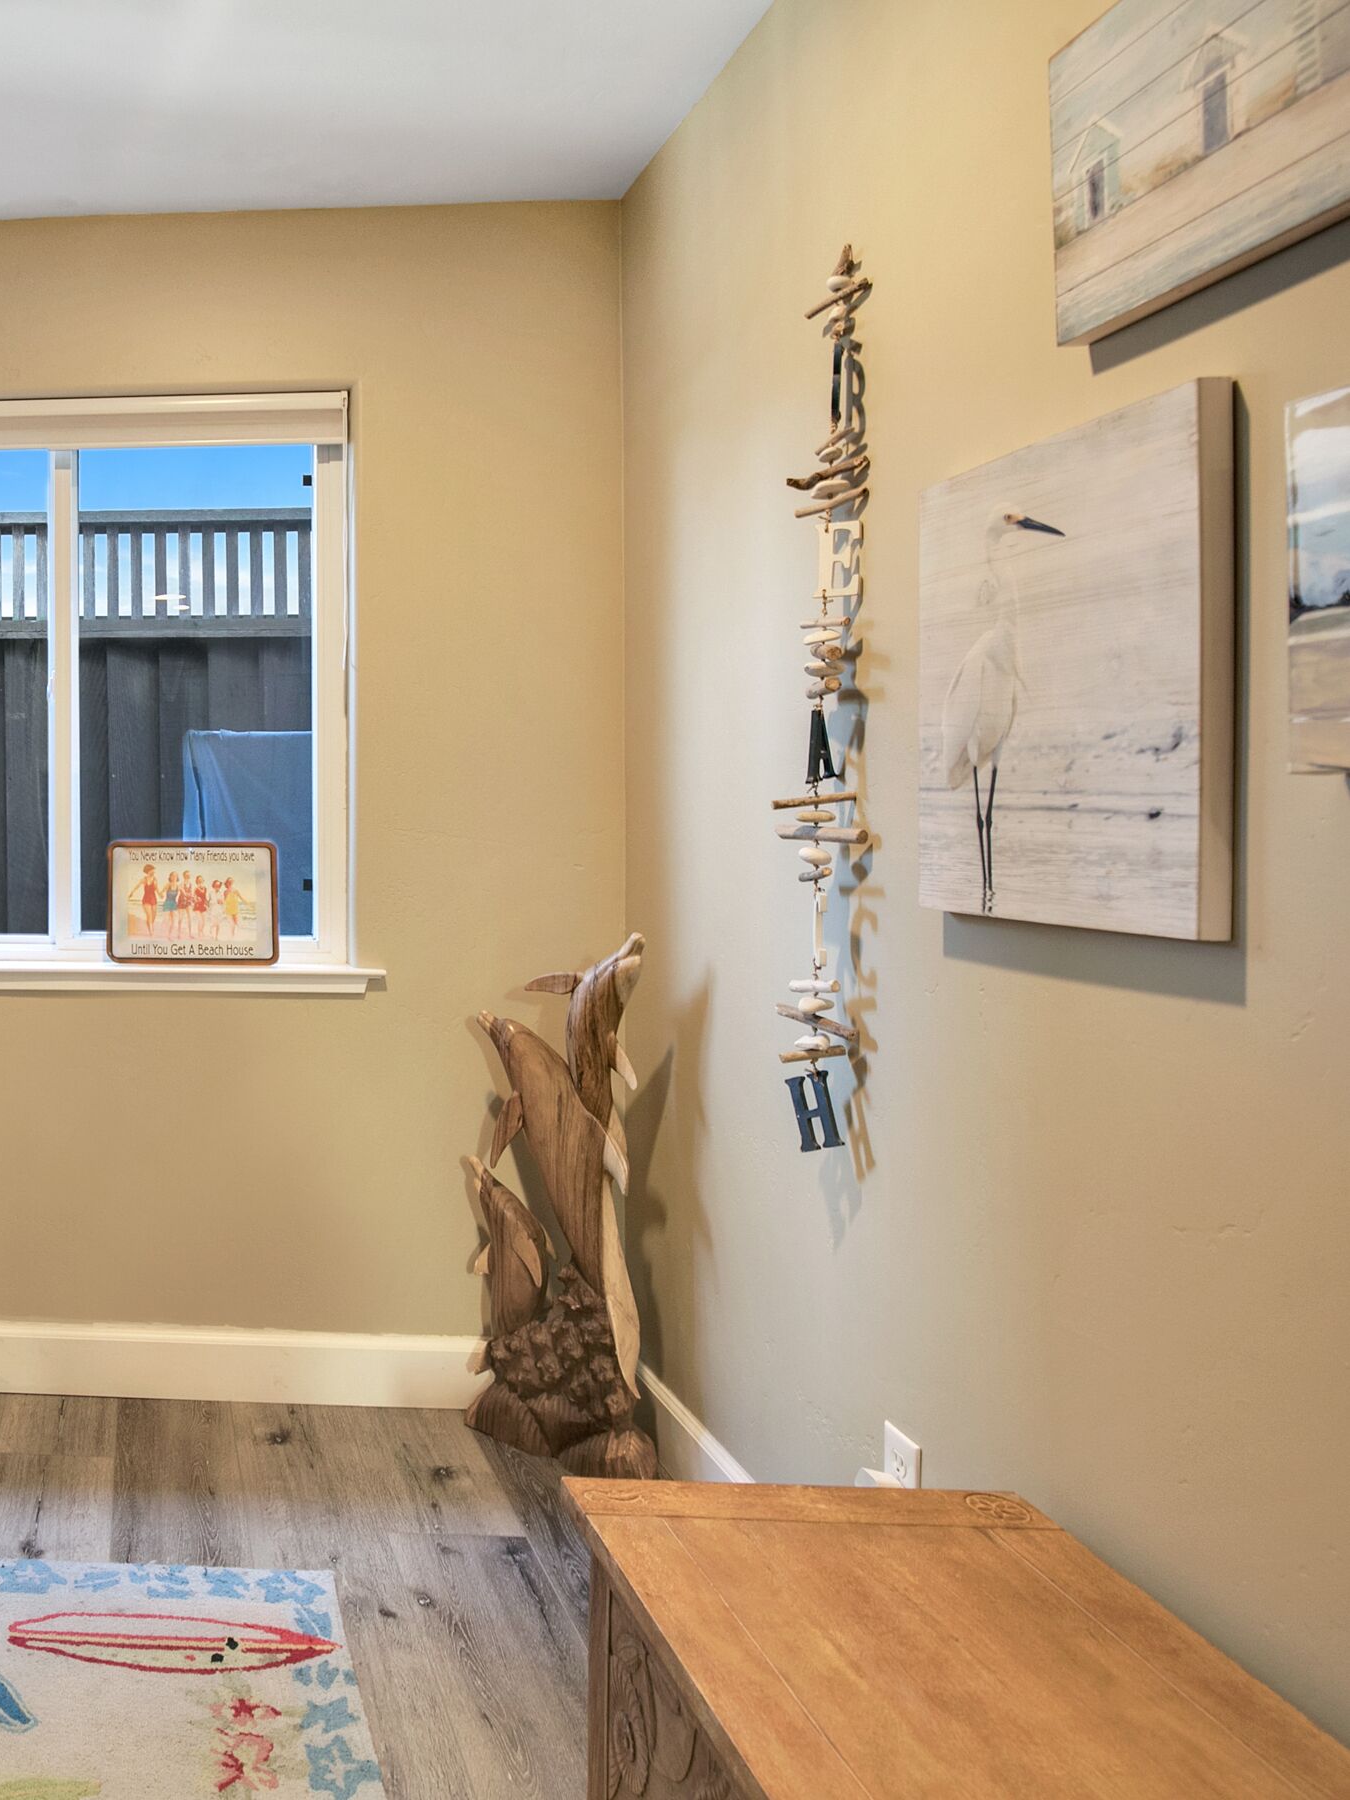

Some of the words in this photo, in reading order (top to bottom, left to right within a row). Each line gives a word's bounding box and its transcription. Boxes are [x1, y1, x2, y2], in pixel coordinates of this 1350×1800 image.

[129, 850, 139, 861] You
[140, 850, 157, 861] Never
[159, 850, 174, 861] Know
[176, 850, 188, 861] How
[207, 850, 227, 861] Friends
[131, 943, 151, 955] Until
[153, 943, 168, 955] You
[170, 943, 186, 955] Get
[189, 943, 195, 955] A
[198, 943, 223, 956] Beach
[226, 943, 254, 956] House
